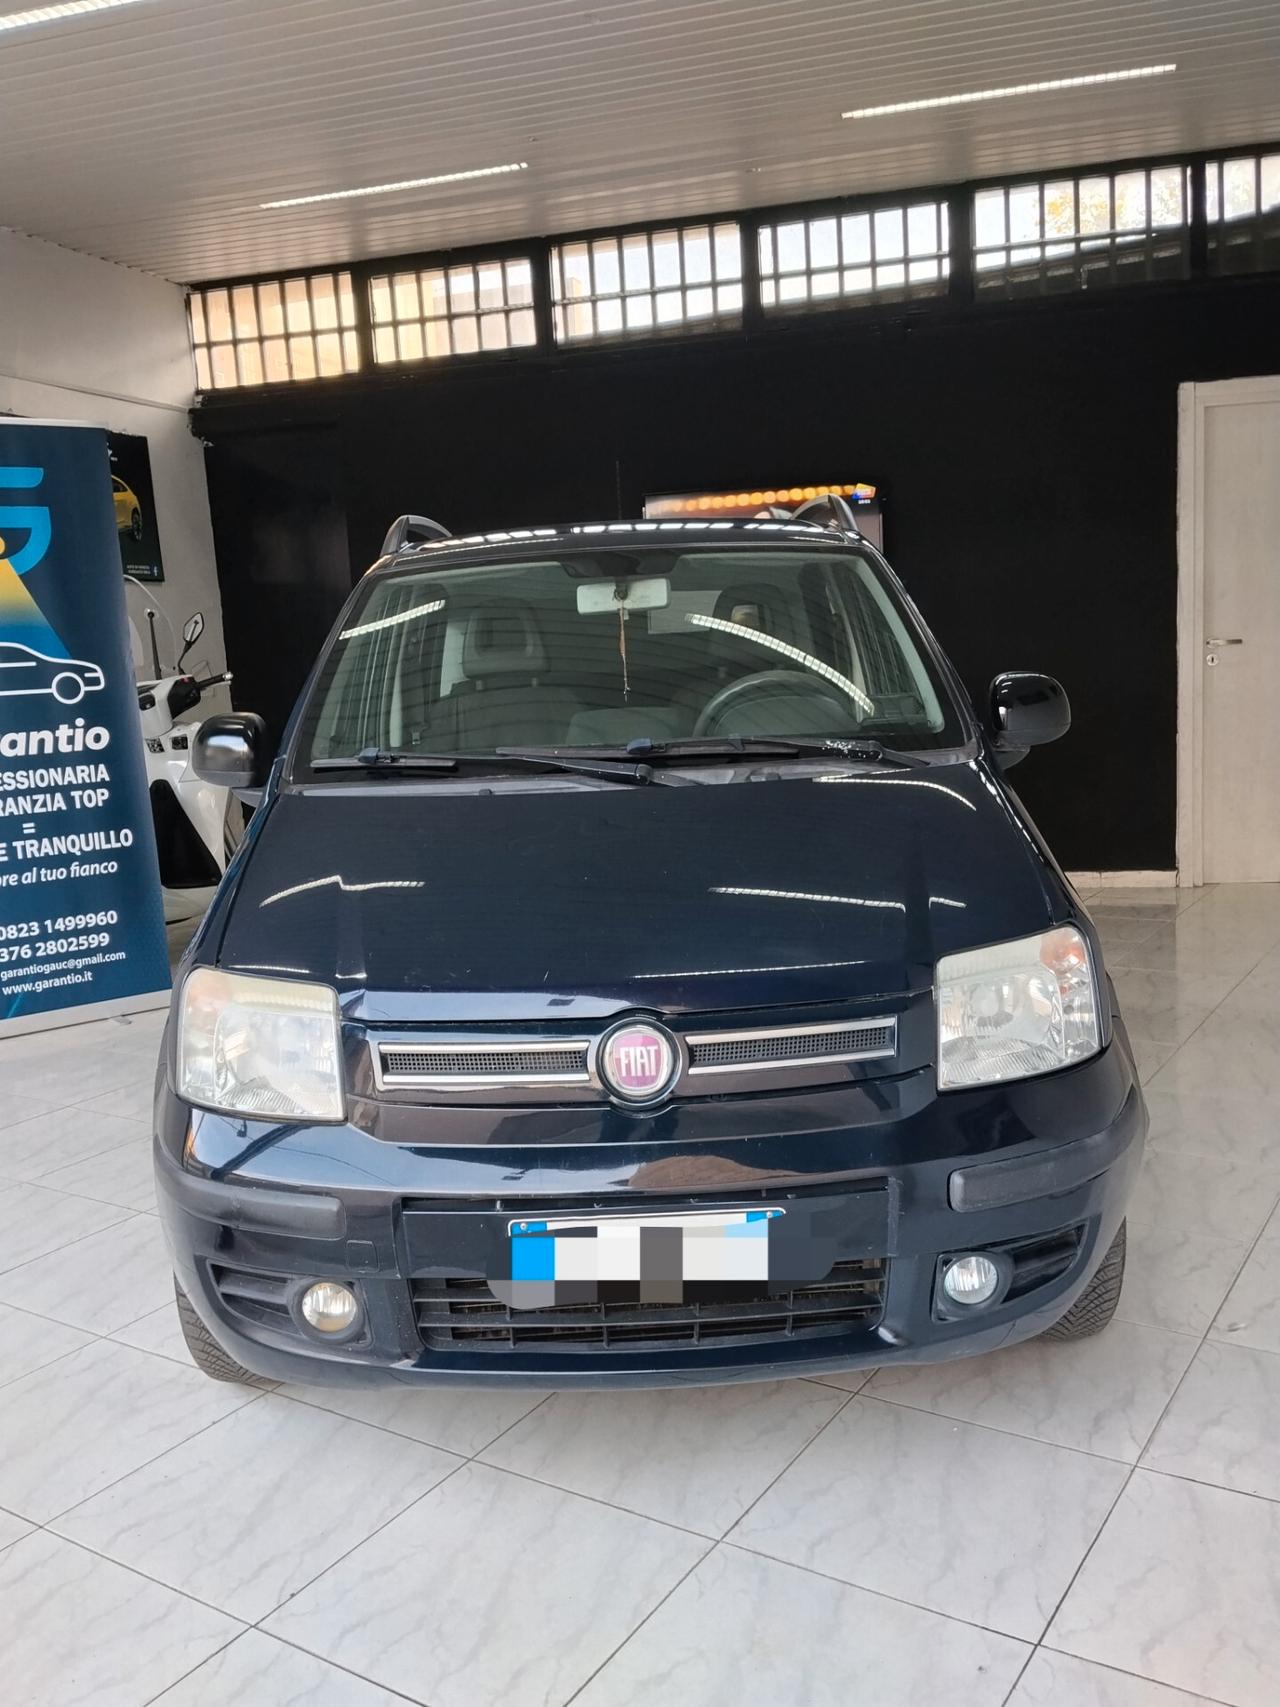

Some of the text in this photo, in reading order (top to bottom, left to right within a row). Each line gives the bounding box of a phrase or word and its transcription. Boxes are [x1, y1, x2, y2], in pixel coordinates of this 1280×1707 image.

[71, 788, 109, 809] TOP
[12, 828, 133, 860] TRANQUILLO
[0, 860, 118, 887] re al tuo fianco
[44, 910, 118, 933] 1499960
[0, 932, 110, 963] 376 2802599
[0, 951, 126, 981] garantiogauc@gmail.com
[2, 970, 93, 996] www.garantio.it
[619, 1045, 658, 1077] FIAT
